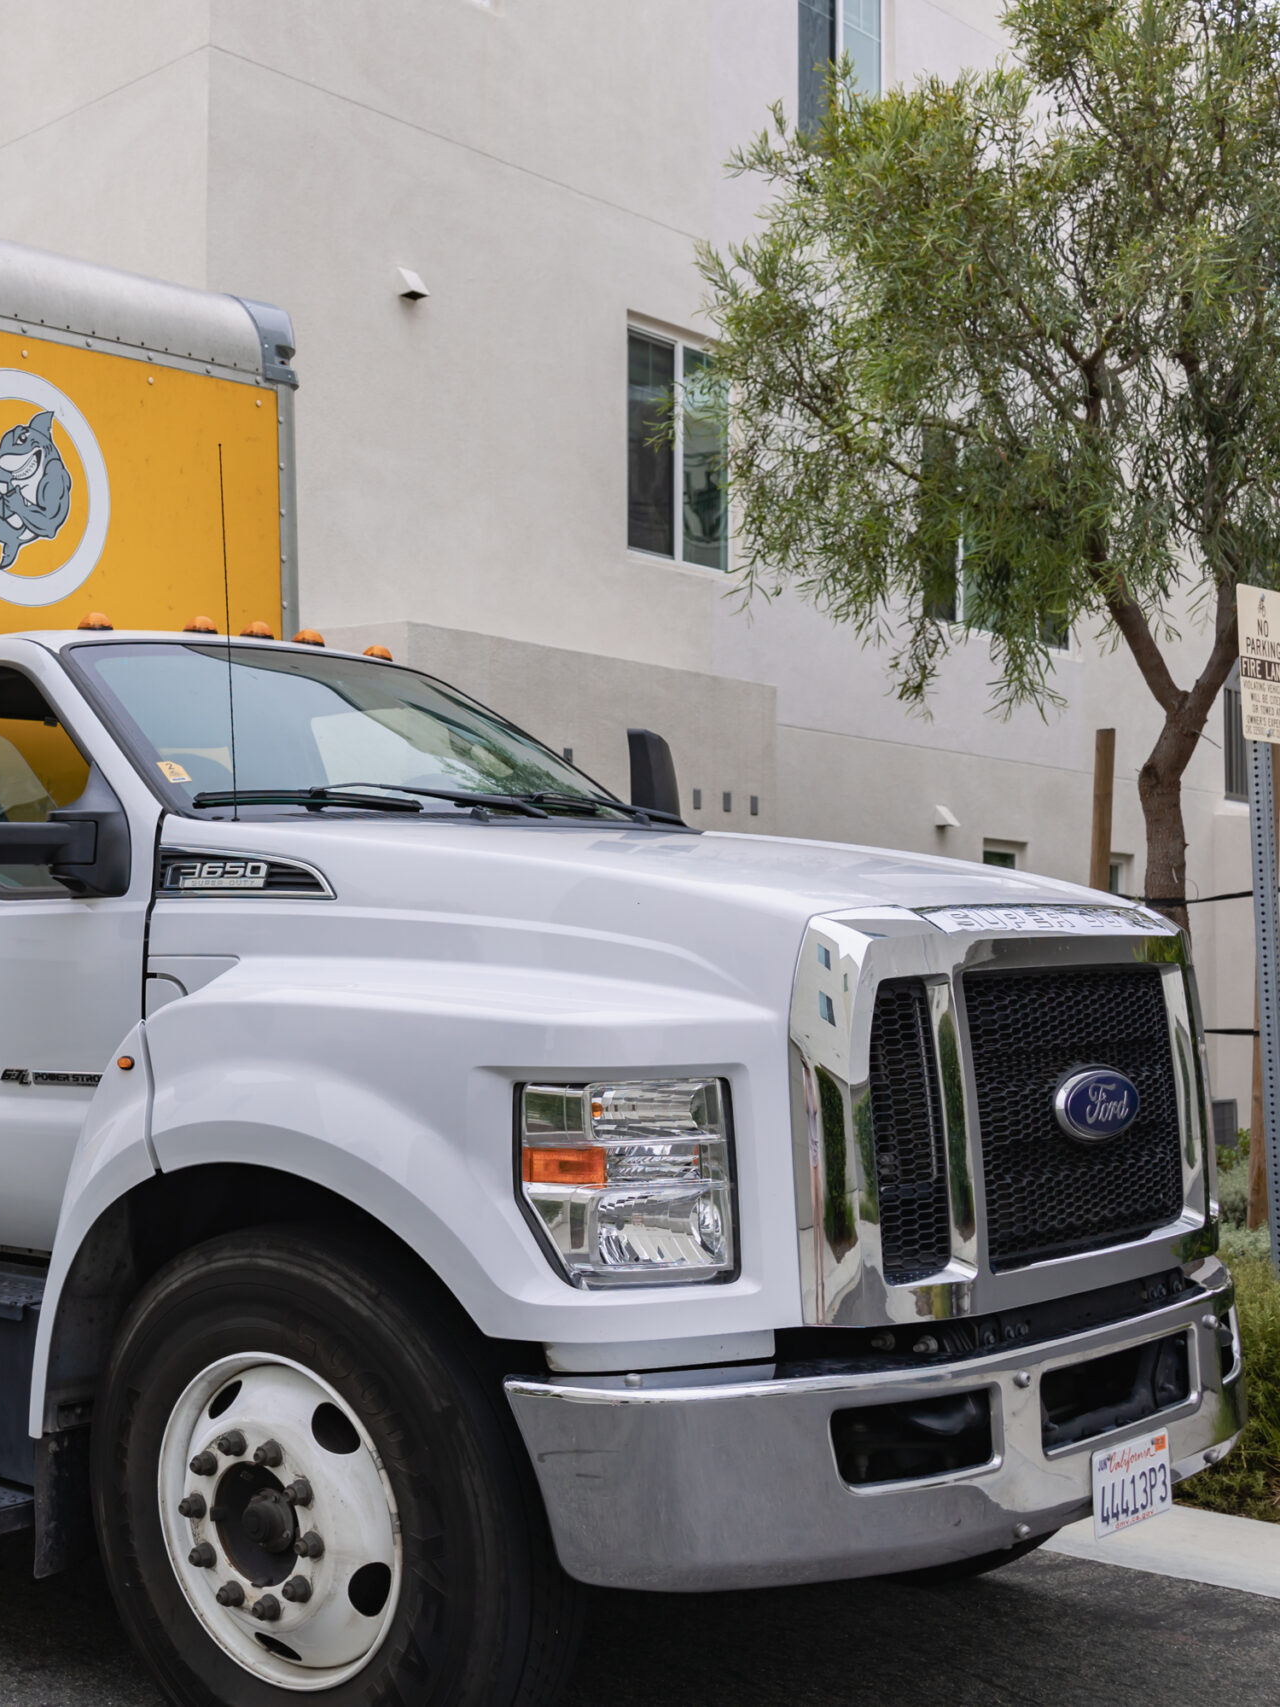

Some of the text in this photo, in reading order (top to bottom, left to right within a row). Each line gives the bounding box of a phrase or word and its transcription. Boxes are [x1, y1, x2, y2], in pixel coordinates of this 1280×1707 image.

[1257, 619, 1269, 637] NO
[1246, 637, 1280, 660] PARKING
[1242, 657, 1262, 678] FIRE
[1086, 1083, 1129, 1124] Ford
[1109, 1447, 1156, 1473] California
[1101, 1463, 1168, 1526] 44413P3
